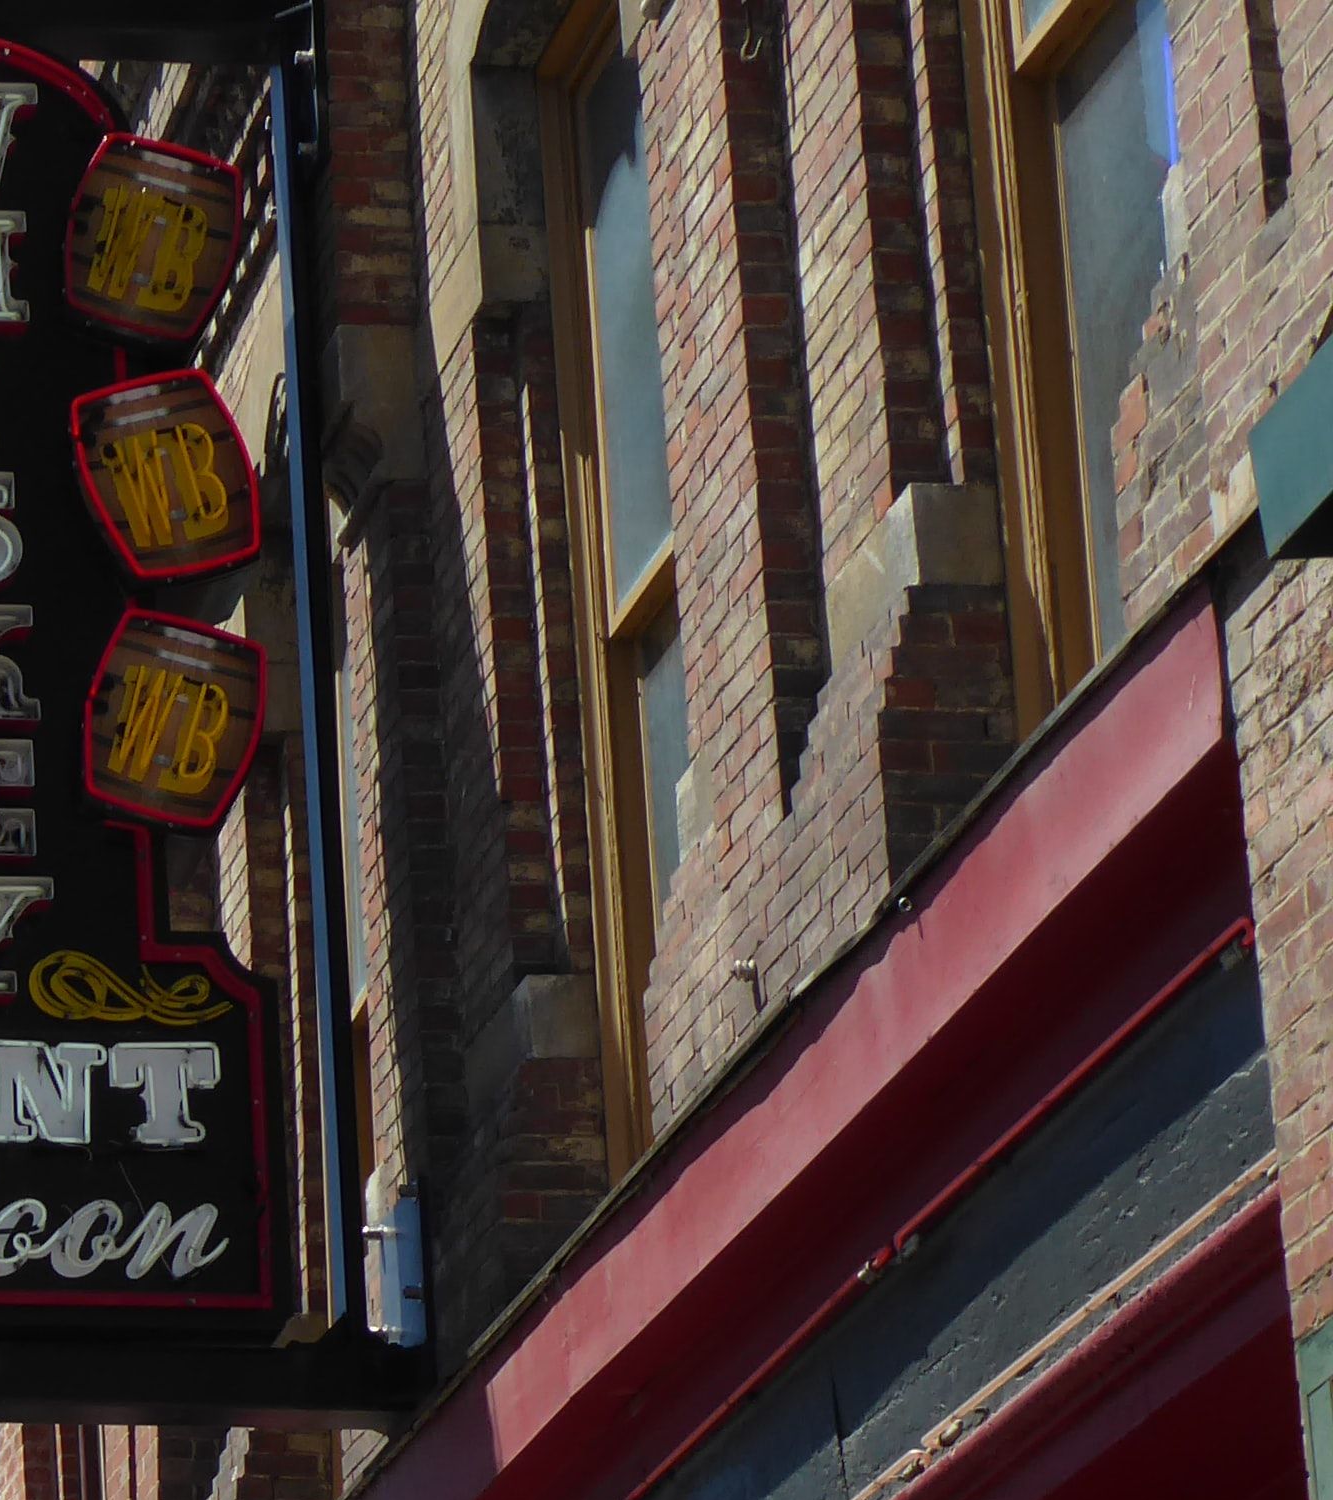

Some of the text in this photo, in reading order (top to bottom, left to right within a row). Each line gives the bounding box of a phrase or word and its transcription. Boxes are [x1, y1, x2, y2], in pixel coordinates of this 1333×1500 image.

[86, 185, 207, 311] WB
[100, 422, 229, 549] WB
[108, 665, 229, 795] WB
